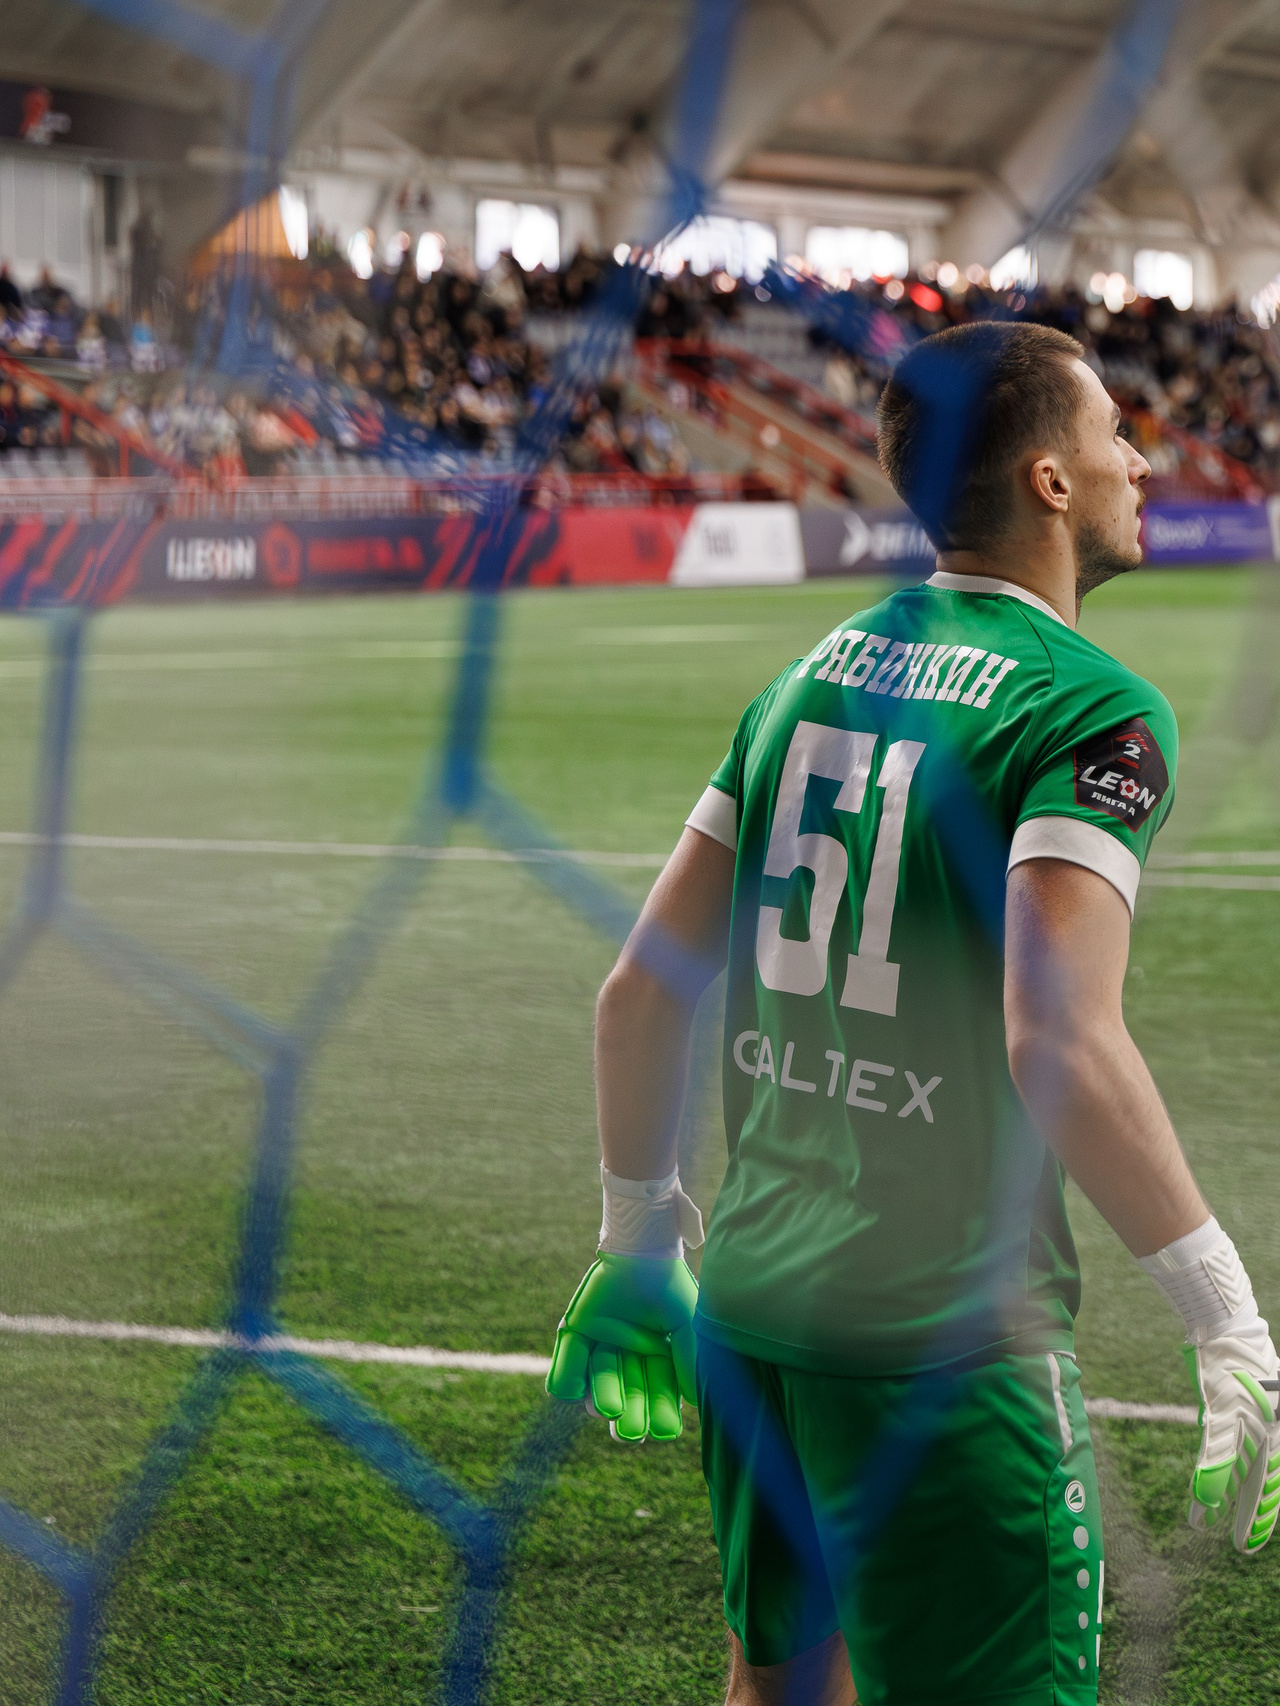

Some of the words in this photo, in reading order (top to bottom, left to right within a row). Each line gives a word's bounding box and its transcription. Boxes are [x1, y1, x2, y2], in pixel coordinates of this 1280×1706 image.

[796, 630, 1020, 710] РЯБИНКИН
[1123, 743, 1141, 759] 2
[1079, 765, 1156, 810] LEON
[1091, 791, 1127, 810] ЛИГА
[756, 720, 927, 1017] 51
